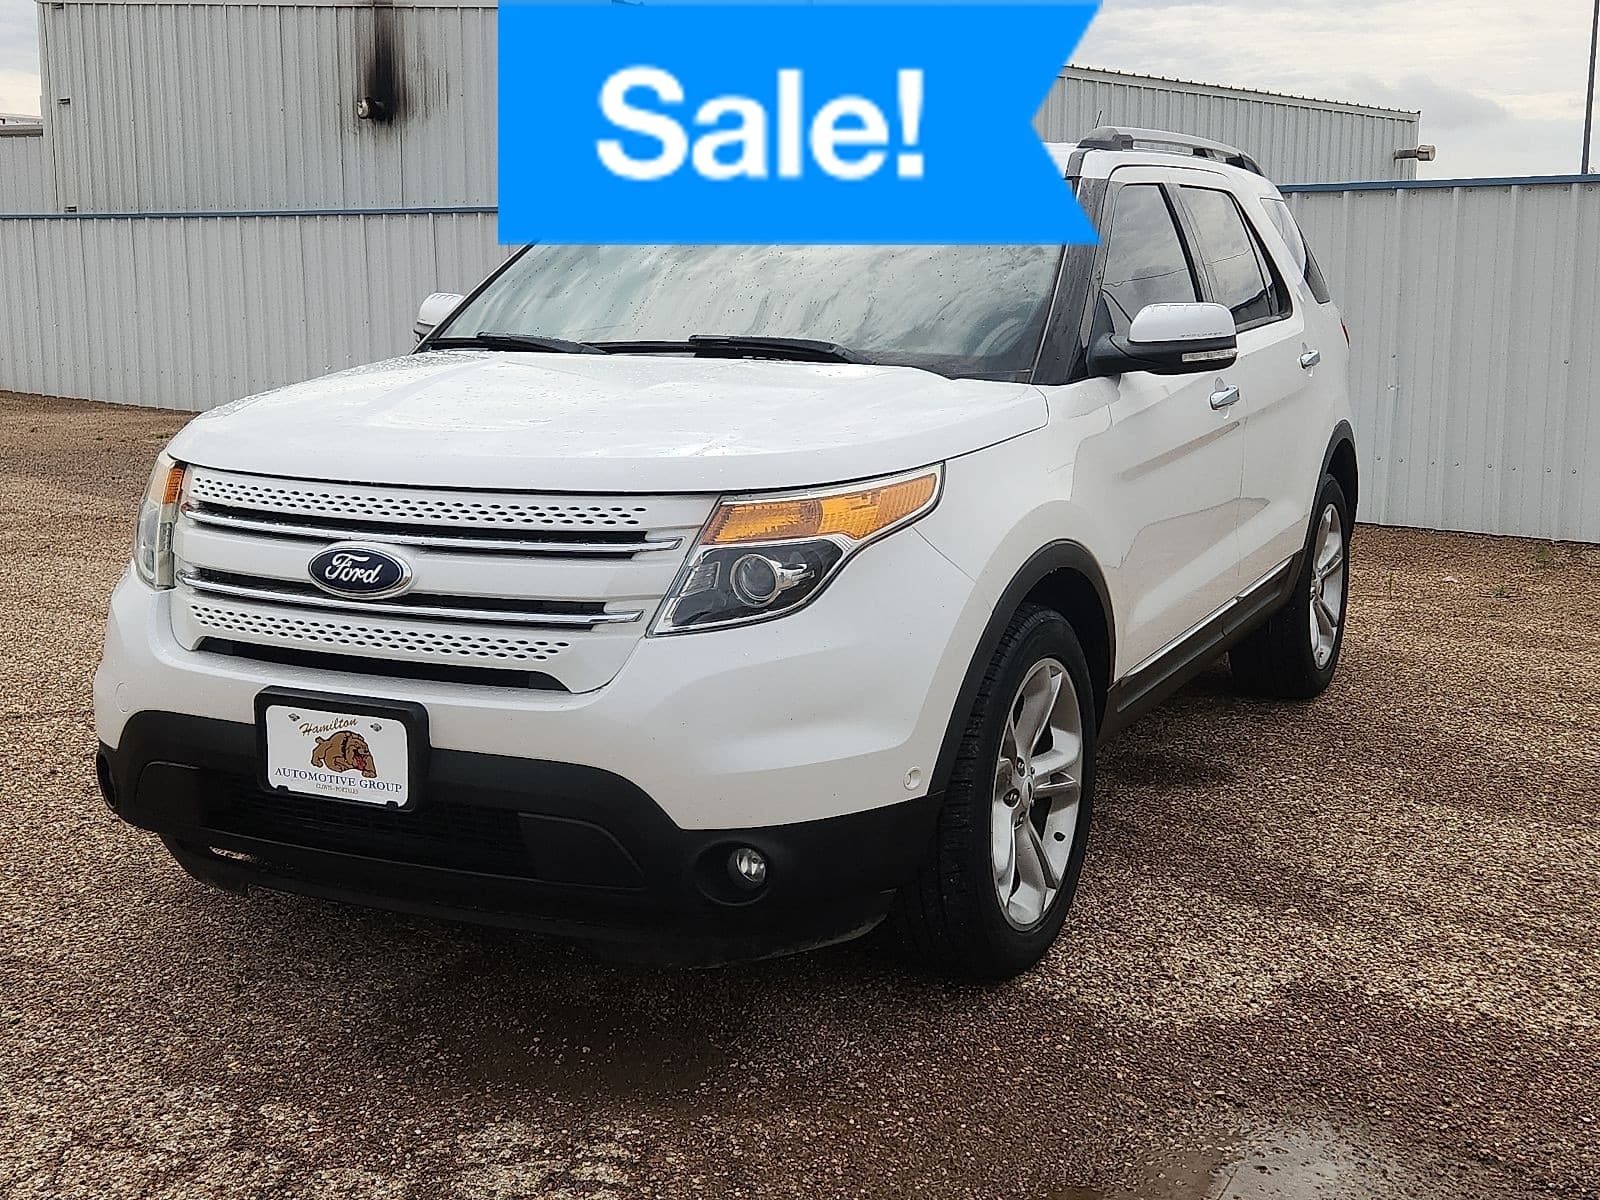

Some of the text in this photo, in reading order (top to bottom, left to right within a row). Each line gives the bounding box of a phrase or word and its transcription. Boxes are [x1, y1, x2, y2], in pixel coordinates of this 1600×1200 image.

[325, 553, 383, 583] Ford
[299, 718, 358, 736] Hamilton
[274, 767, 402, 793] AUTOMOTIVE GROUP
